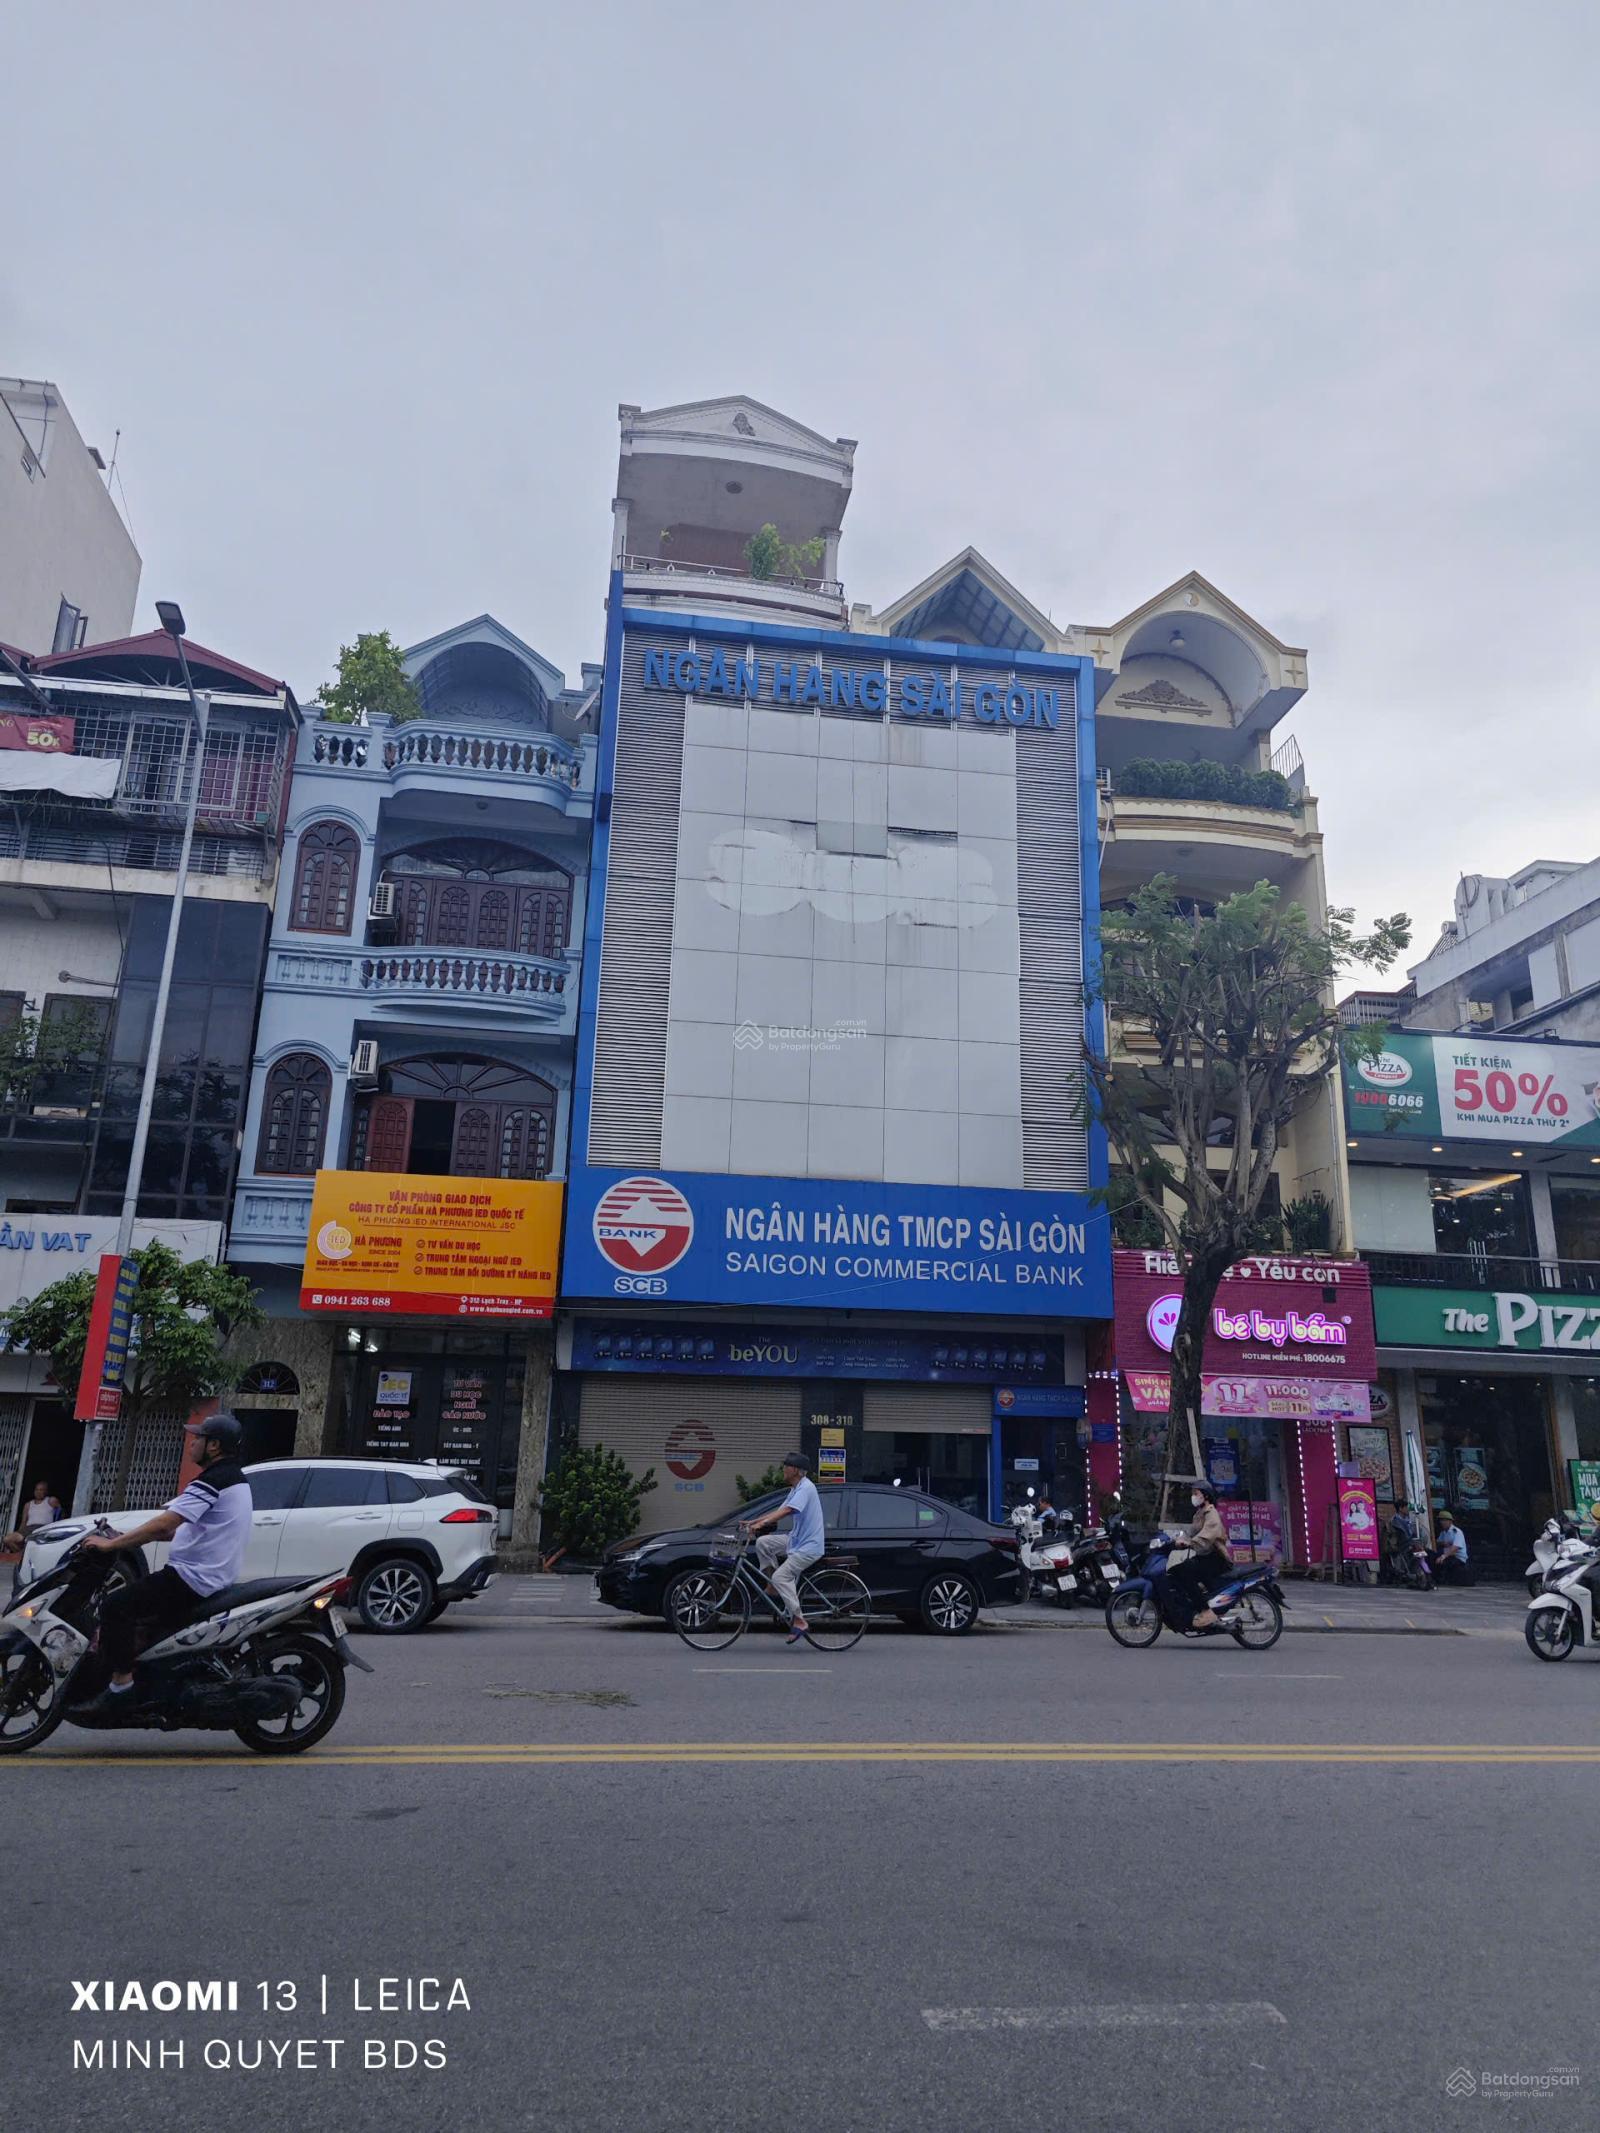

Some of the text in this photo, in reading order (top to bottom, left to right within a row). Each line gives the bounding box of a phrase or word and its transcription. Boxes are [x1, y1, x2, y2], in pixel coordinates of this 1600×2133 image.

[643, 648, 759, 698] NGÂN
[900, 671, 961, 719] SÀI
[973, 676, 1059, 730] GÒN
[1367, 1059, 1403, 1073] PIZZA
[1452, 1052, 1512, 1071] TIẾT KIỆM
[1454, 1068, 1568, 1117] 50%
[1456, 1112, 1475, 1122] KHI
[1477, 1114, 1501, 1124] MUA
[1503, 1115, 1534, 1126] PIZZA
[1536, 1117, 1557, 1127] THỨ
[410, 1190, 442, 1203] PHÒNG
[444, 1193, 467, 1204] GIAO
[469, 1194, 492, 1206] DỊCH
[348, 1202, 373, 1213] CÔNG
[375, 1203, 386, 1212] TY
[474, 1208, 489, 1218] IED
[490, 1207, 512, 1220] QUỐC
[514, 1207, 526, 1220] TẾ
[430, 1219, 497, 1229] INTERNATIONAL
[725, 1201, 1086, 1255] NGÂN HÀNG TMCP SÀI GÒN
[598, 1227, 657, 1240] BANK
[41, 1232, 92, 1253] VAT
[428, 1239, 481, 1252] TƯ VẤN DU HỌC
[426, 1253, 450, 1263] TRUNG
[451, 1253, 467, 1263] TÂM
[468, 1254, 491, 1266] NGOẠI
[510, 1257, 522, 1266] IED
[424, 1266, 448, 1276] TRUNG
[449, 1266, 465, 1277] TÂM
[539, 1271, 551, 1280] IED
[725, 1251, 1085, 1287] SAIGON COMMERCIAL BANK
[1255, 1259, 1297, 1281] Yêu
[1301, 1266, 1341, 1284] con
[614, 1276, 668, 1295] SCB
[324, 1295, 391, 1307] 0941 263 688
[1213, 1308, 1251, 1340] bé
[1250, 1310, 1288, 1348] bụ
[1442, 1308, 1490, 1333] The
[730, 1344, 799, 1363] beYOU
[1242, 1352, 1273, 1362] HOTLINE
[1303, 1353, 1346, 1364] 18006675
[380, 1390, 401, 1400] QUỐC
[1217, 1382, 1247, 1404] 11
[1264, 1384, 1310, 1400] 11.000
[1578, 1472, 1599, 1487] MUA
[674, 1483, 705, 1493] SCB
